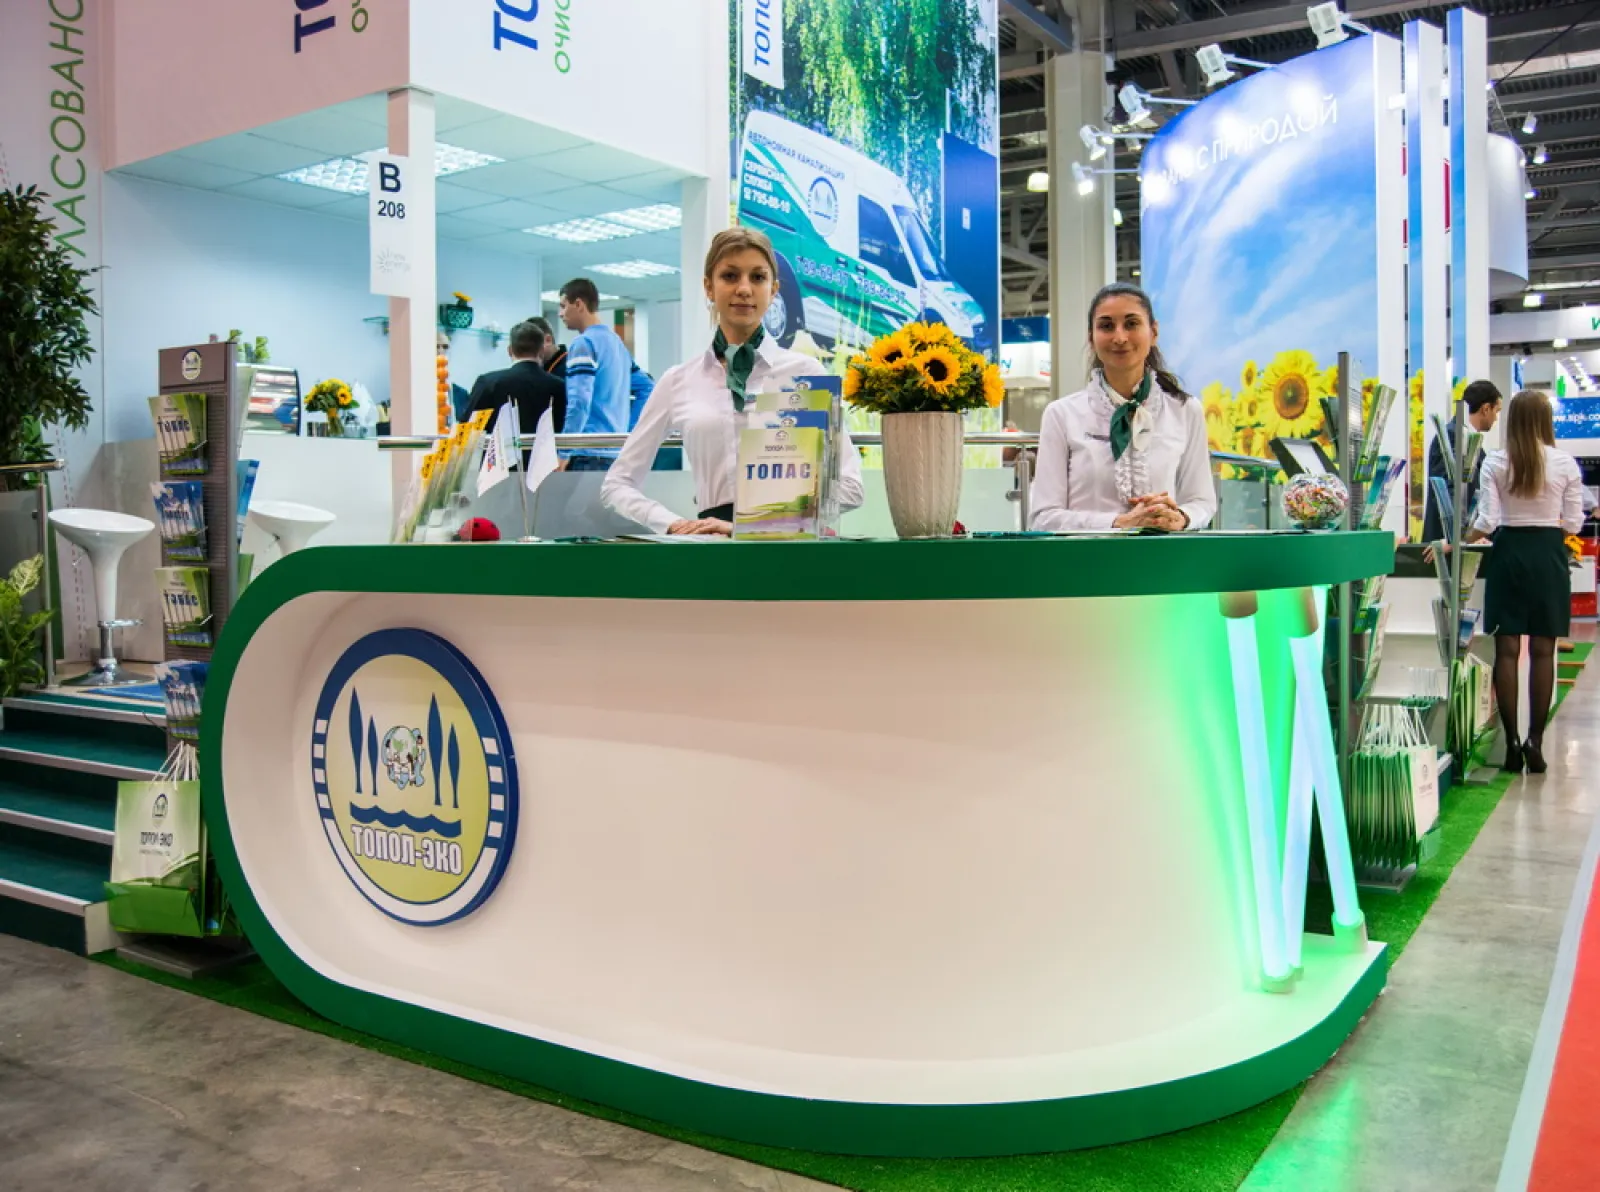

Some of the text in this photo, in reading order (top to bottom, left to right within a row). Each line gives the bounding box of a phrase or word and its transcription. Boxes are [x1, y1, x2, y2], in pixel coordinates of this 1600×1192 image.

[377, 200, 406, 219] 208
[746, 462, 811, 480] ТОПАС
[351, 823, 463, 876] ТОПОЛ-ЭКО
